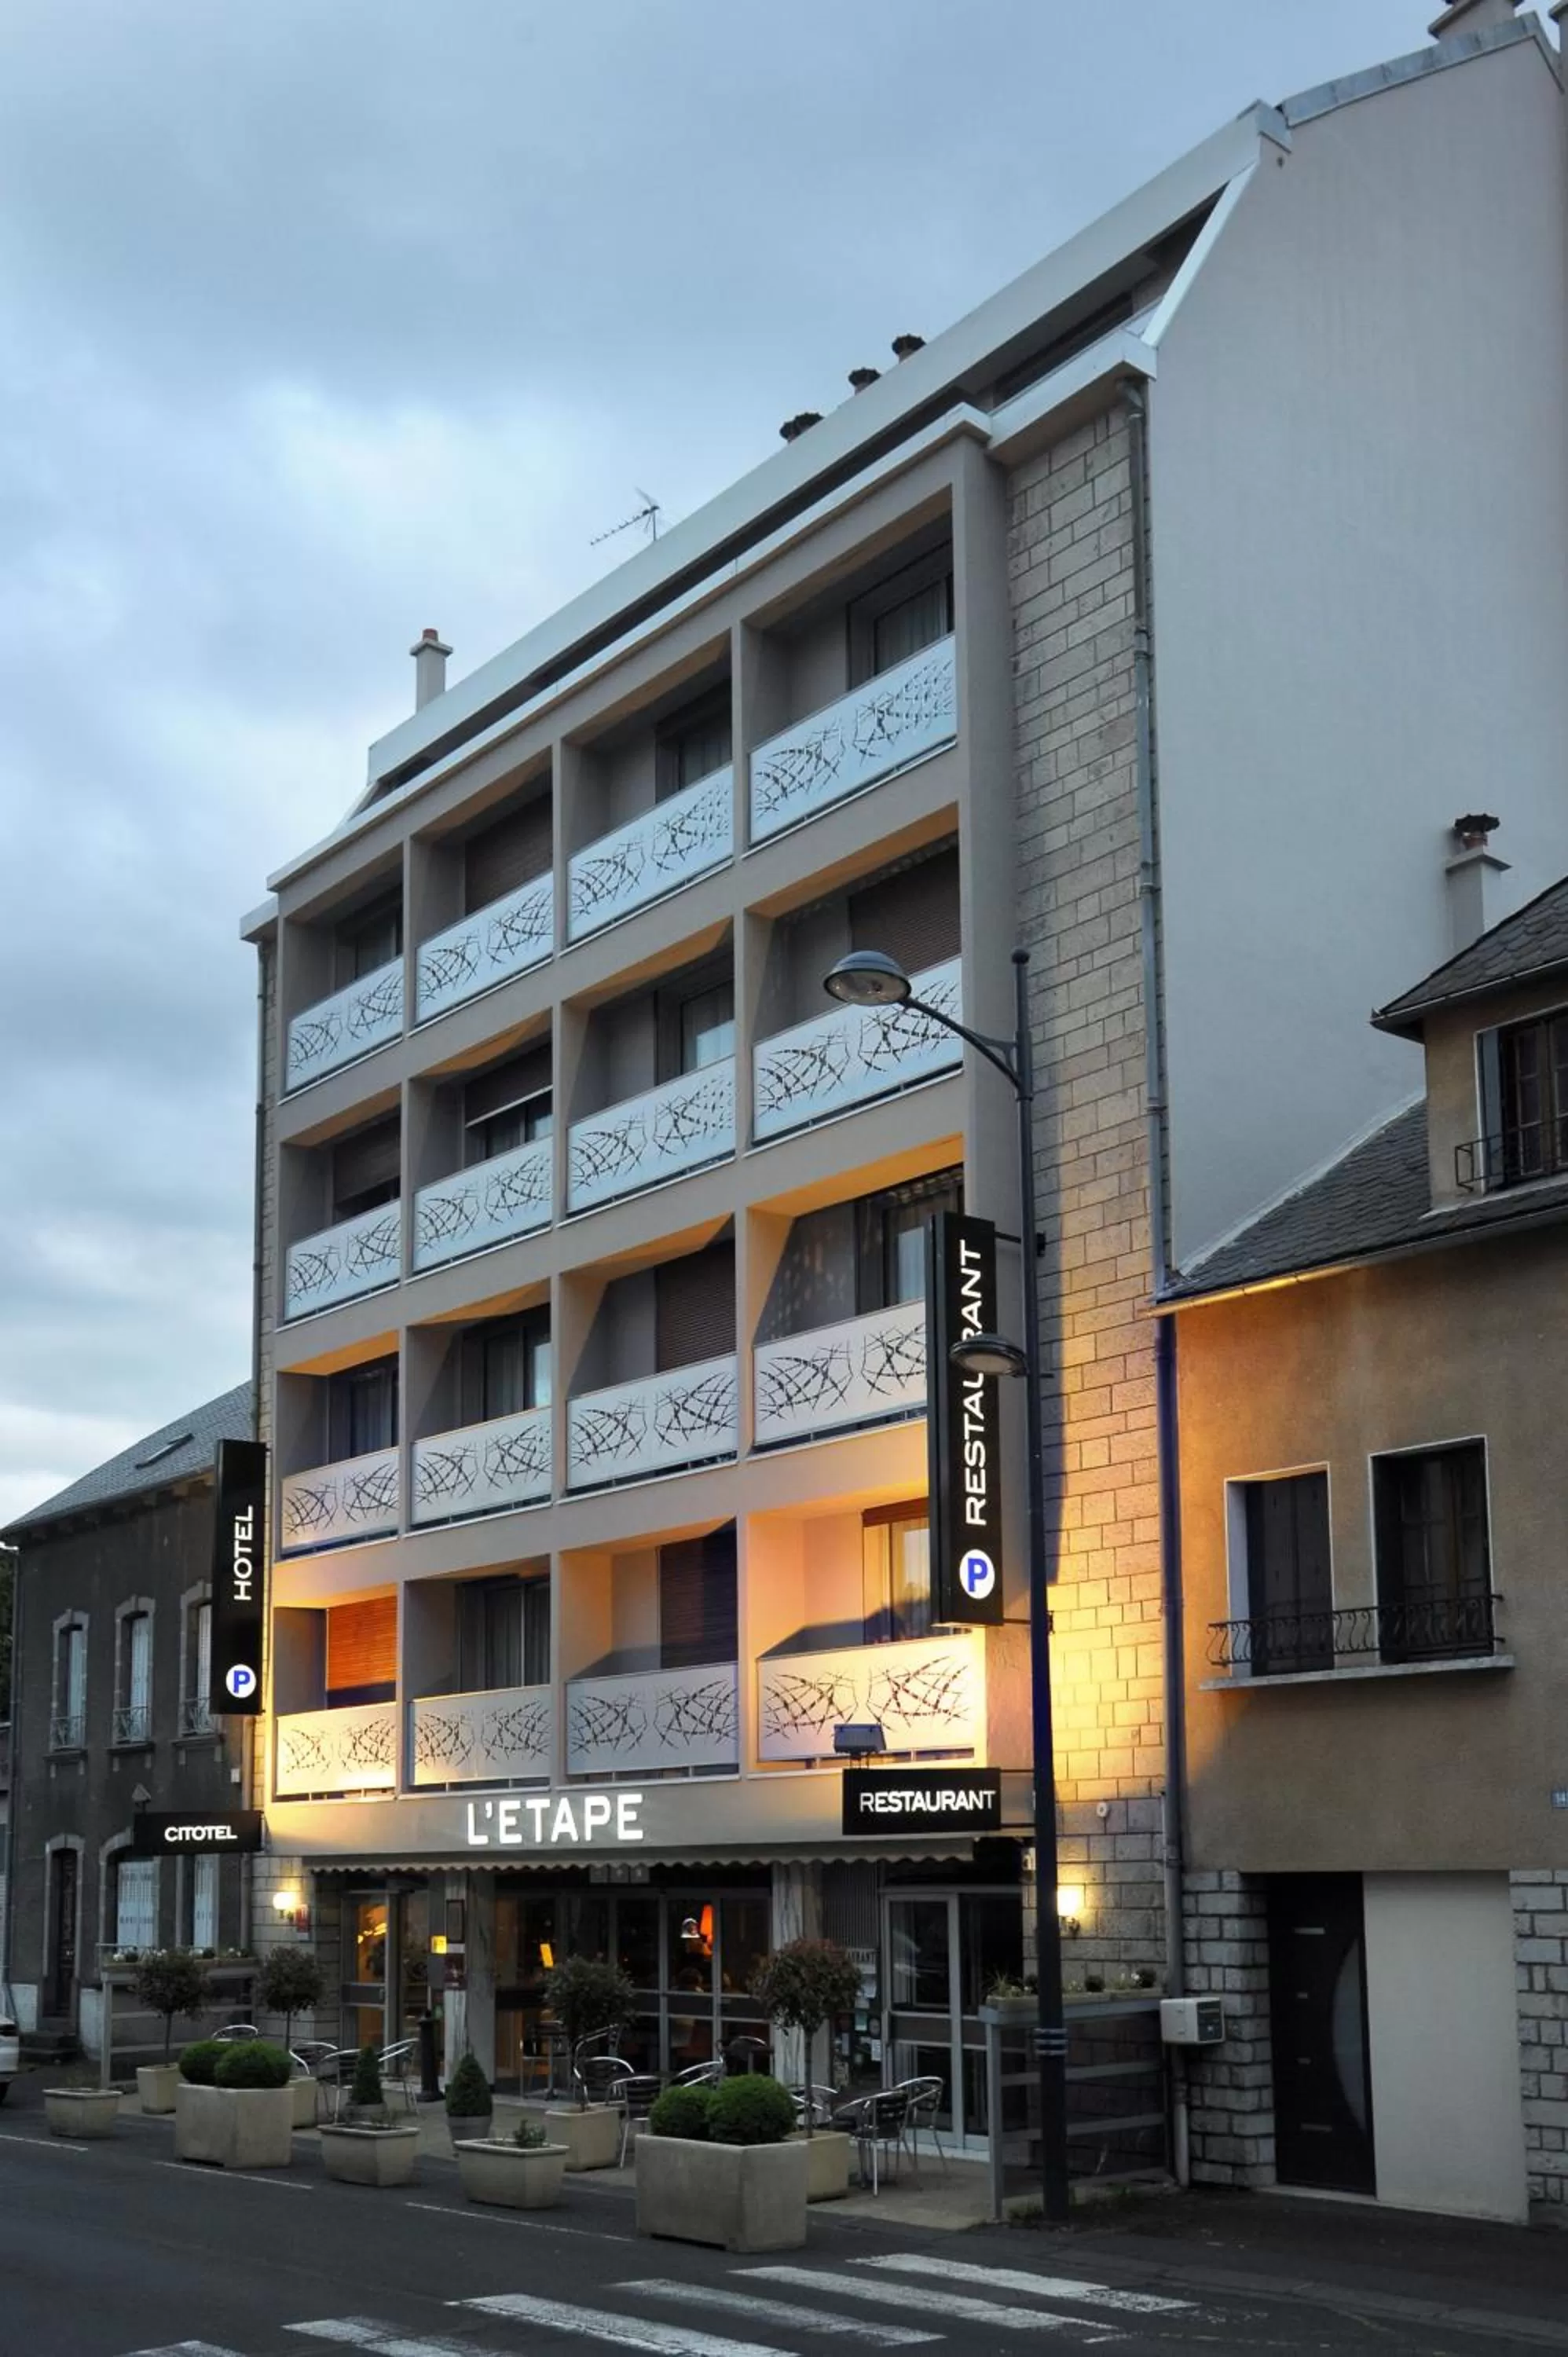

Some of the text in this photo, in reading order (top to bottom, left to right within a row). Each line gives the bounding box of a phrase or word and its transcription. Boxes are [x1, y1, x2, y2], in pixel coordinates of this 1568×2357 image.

[234, 1505, 253, 1601] HOTEL
[968, 1558, 987, 1592] P
[233, 1670, 251, 1693] P
[860, 1790, 996, 1813] RESTAURANT
[164, 1825, 238, 1842] CITOTEL
[467, 1794, 643, 1845] L'ETAPE
